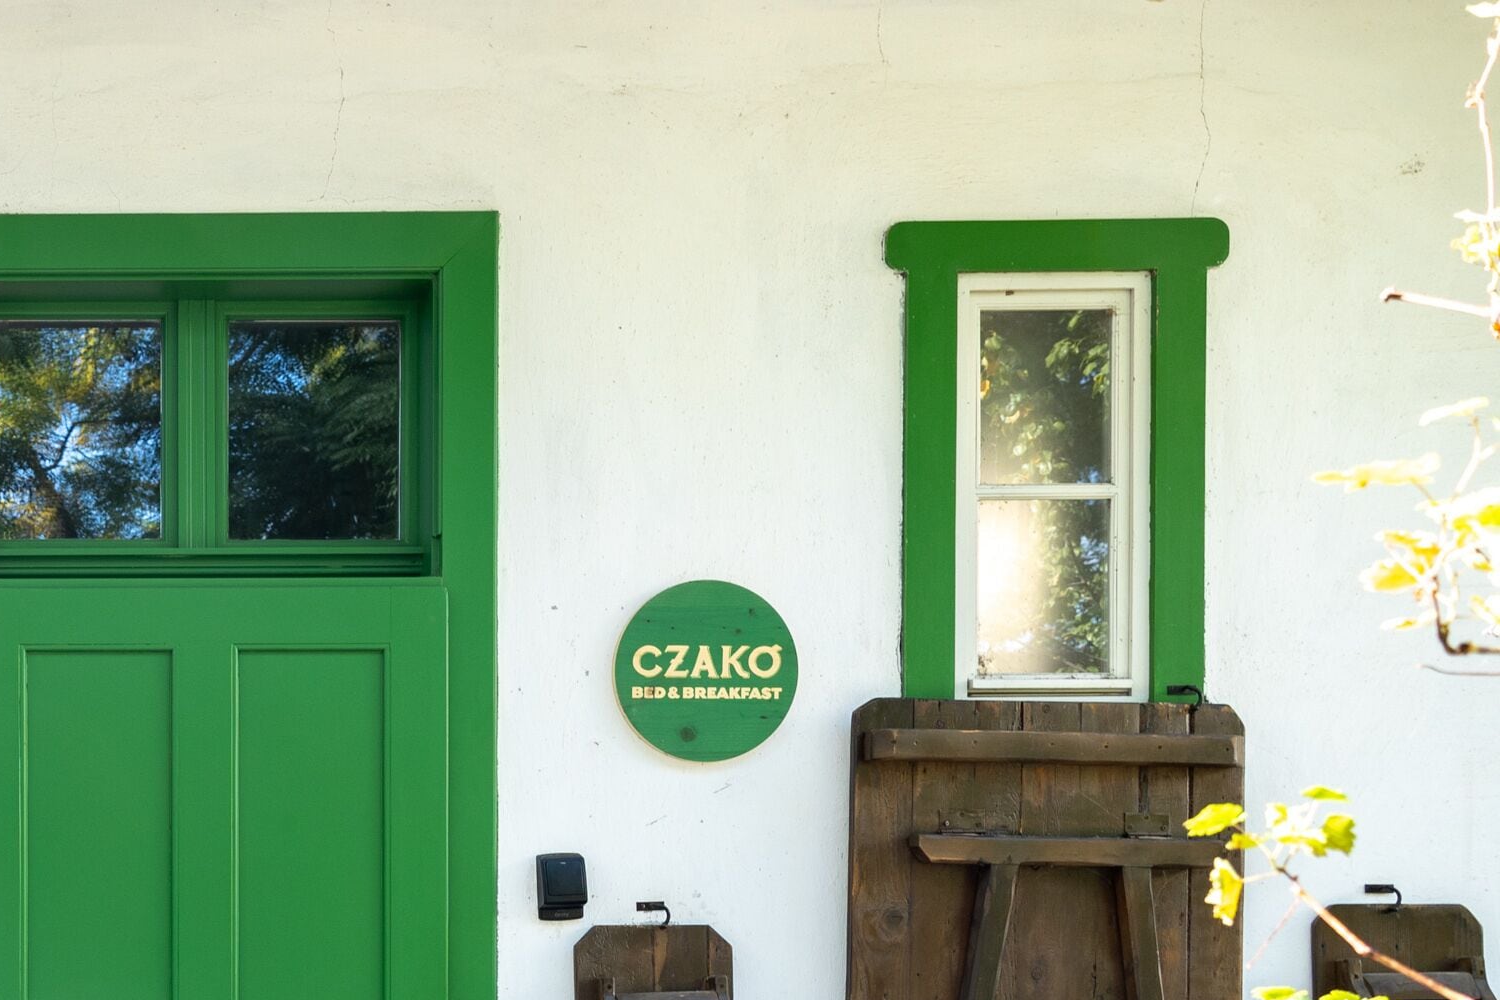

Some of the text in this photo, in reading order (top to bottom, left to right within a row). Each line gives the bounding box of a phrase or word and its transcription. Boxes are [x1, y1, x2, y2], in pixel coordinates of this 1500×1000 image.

[631, 685, 783, 700] BED & BREAKFAST
